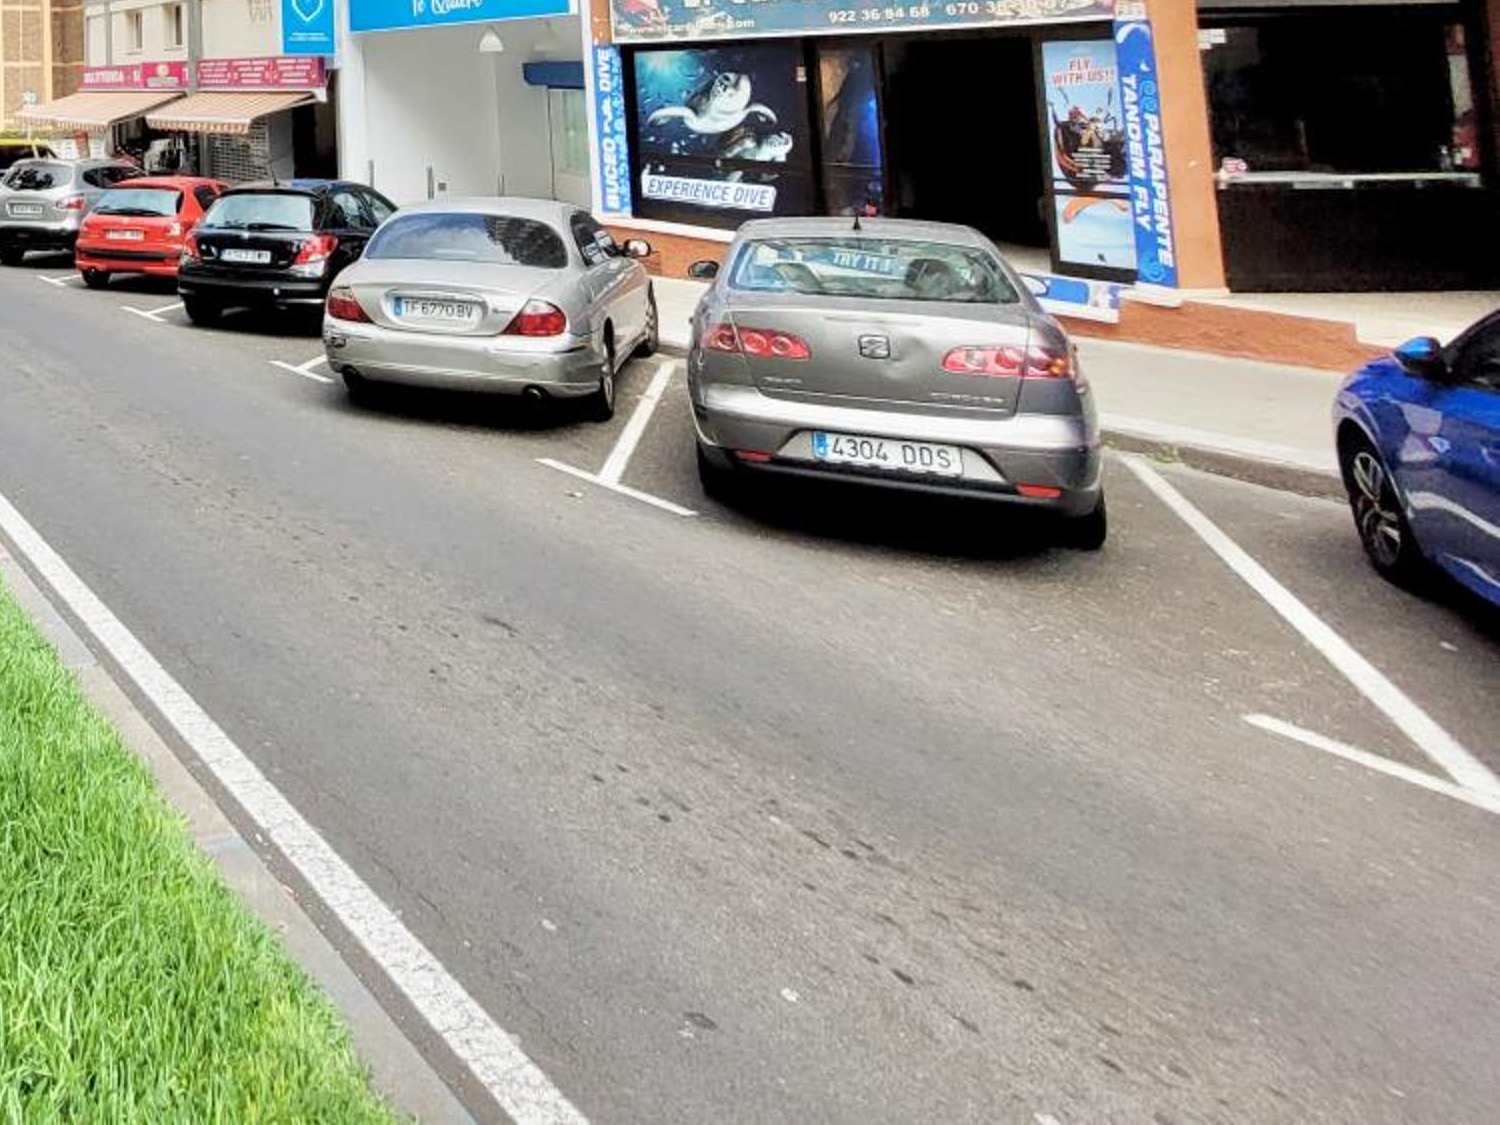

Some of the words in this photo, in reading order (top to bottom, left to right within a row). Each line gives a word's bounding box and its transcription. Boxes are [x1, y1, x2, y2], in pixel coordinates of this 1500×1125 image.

[946, 1, 979, 17] 670
[597, 49, 612, 92] DIVE
[1121, 74, 1146, 179] TANDEM
[602, 139, 621, 209] BUCEO
[647, 178, 732, 201] EXPERIENCE
[733, 185, 770, 206] DIVE
[1145, 114, 1175, 268] PARAPENTE
[1133, 186, 1152, 232] FLY
[404, 299, 419, 314] TF
[832, 437, 889, 462] 4304
